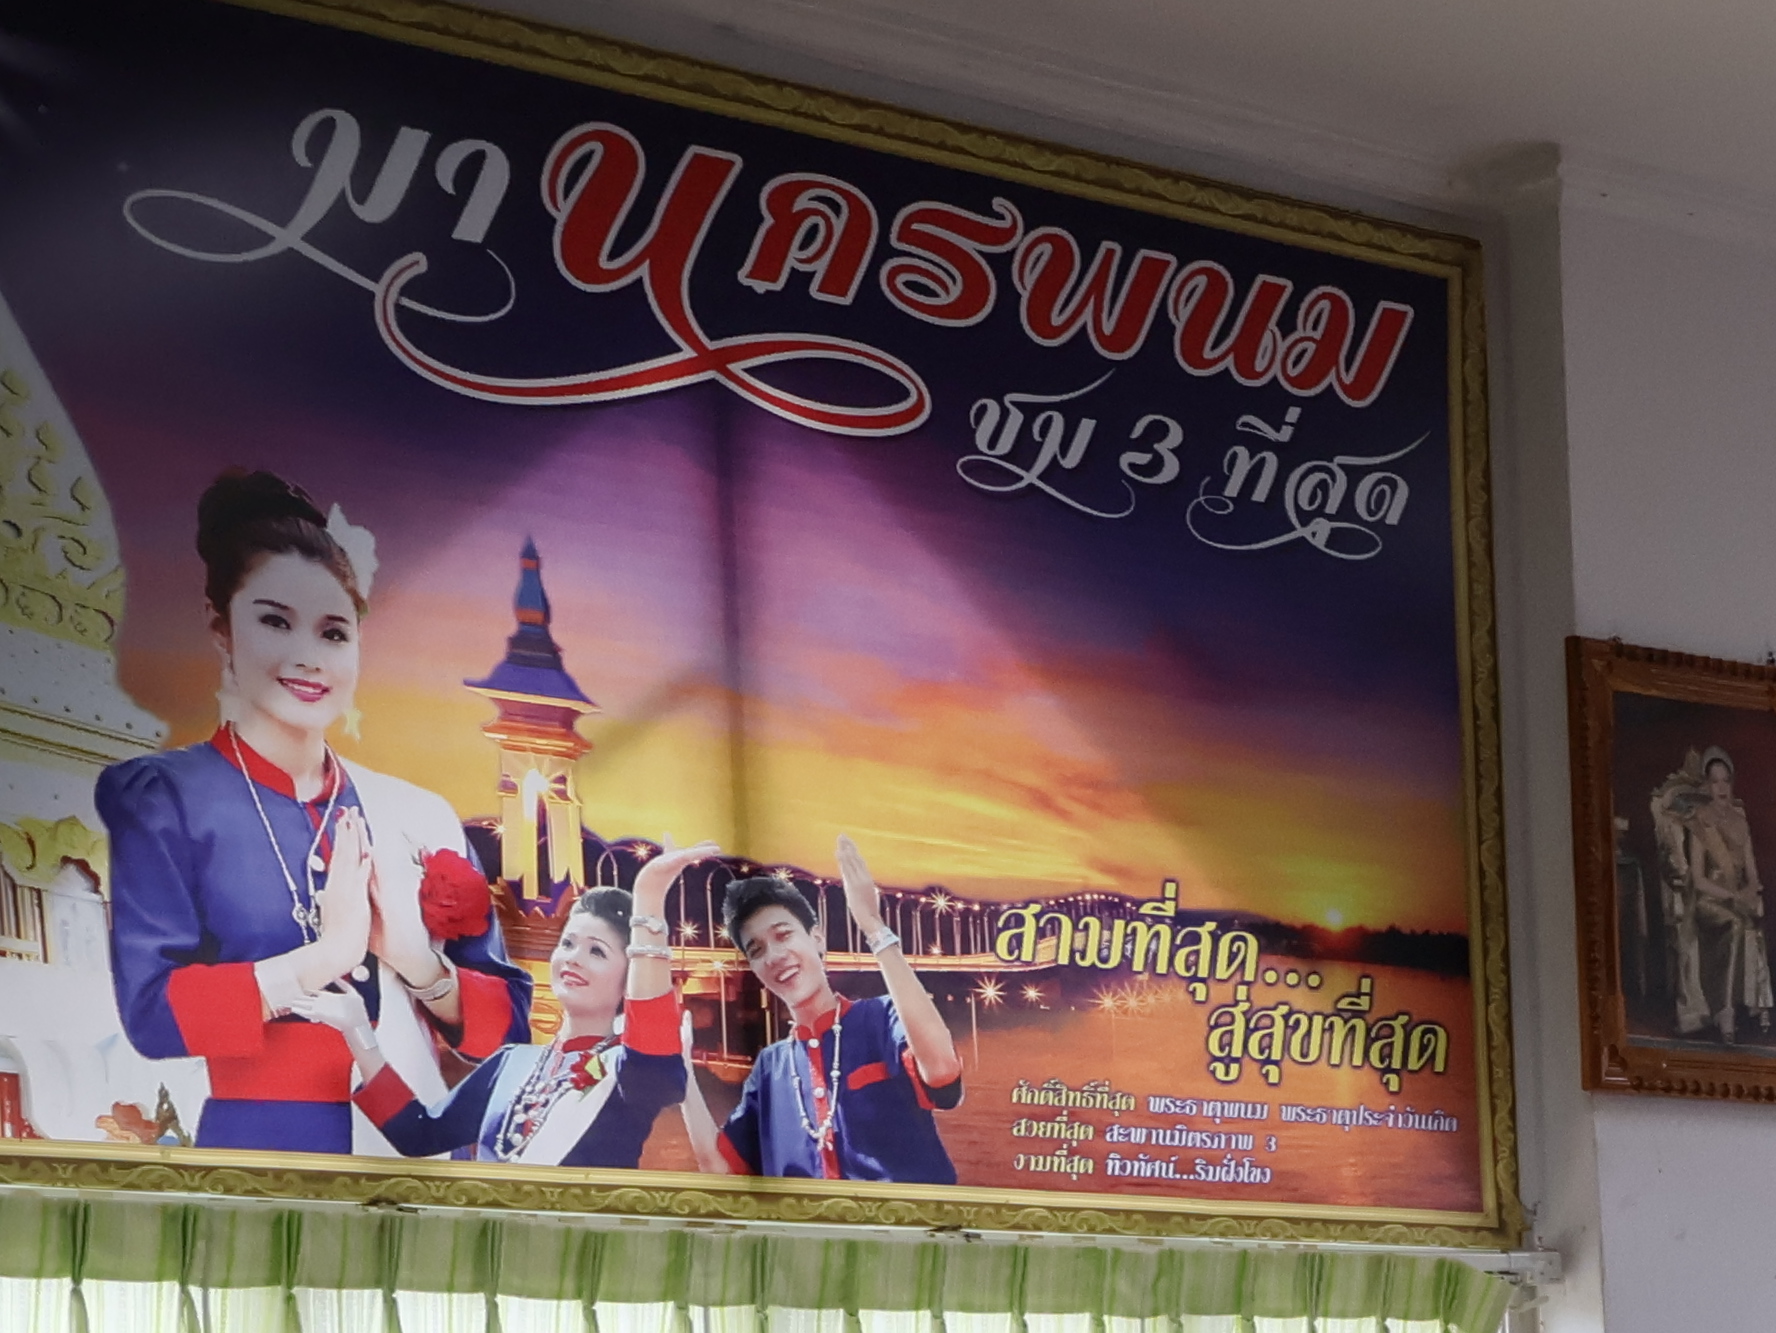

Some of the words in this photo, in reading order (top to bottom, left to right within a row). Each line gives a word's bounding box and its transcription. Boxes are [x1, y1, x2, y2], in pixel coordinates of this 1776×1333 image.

[1128, 412, 1186, 485] 3
[1206, 977, 1450, 1093] สู่สุขที่สุด
[1011, 1111, 1094, 1148] สวยที่สุด
[1012, 1145, 1094, 1181] งามที่สุด
